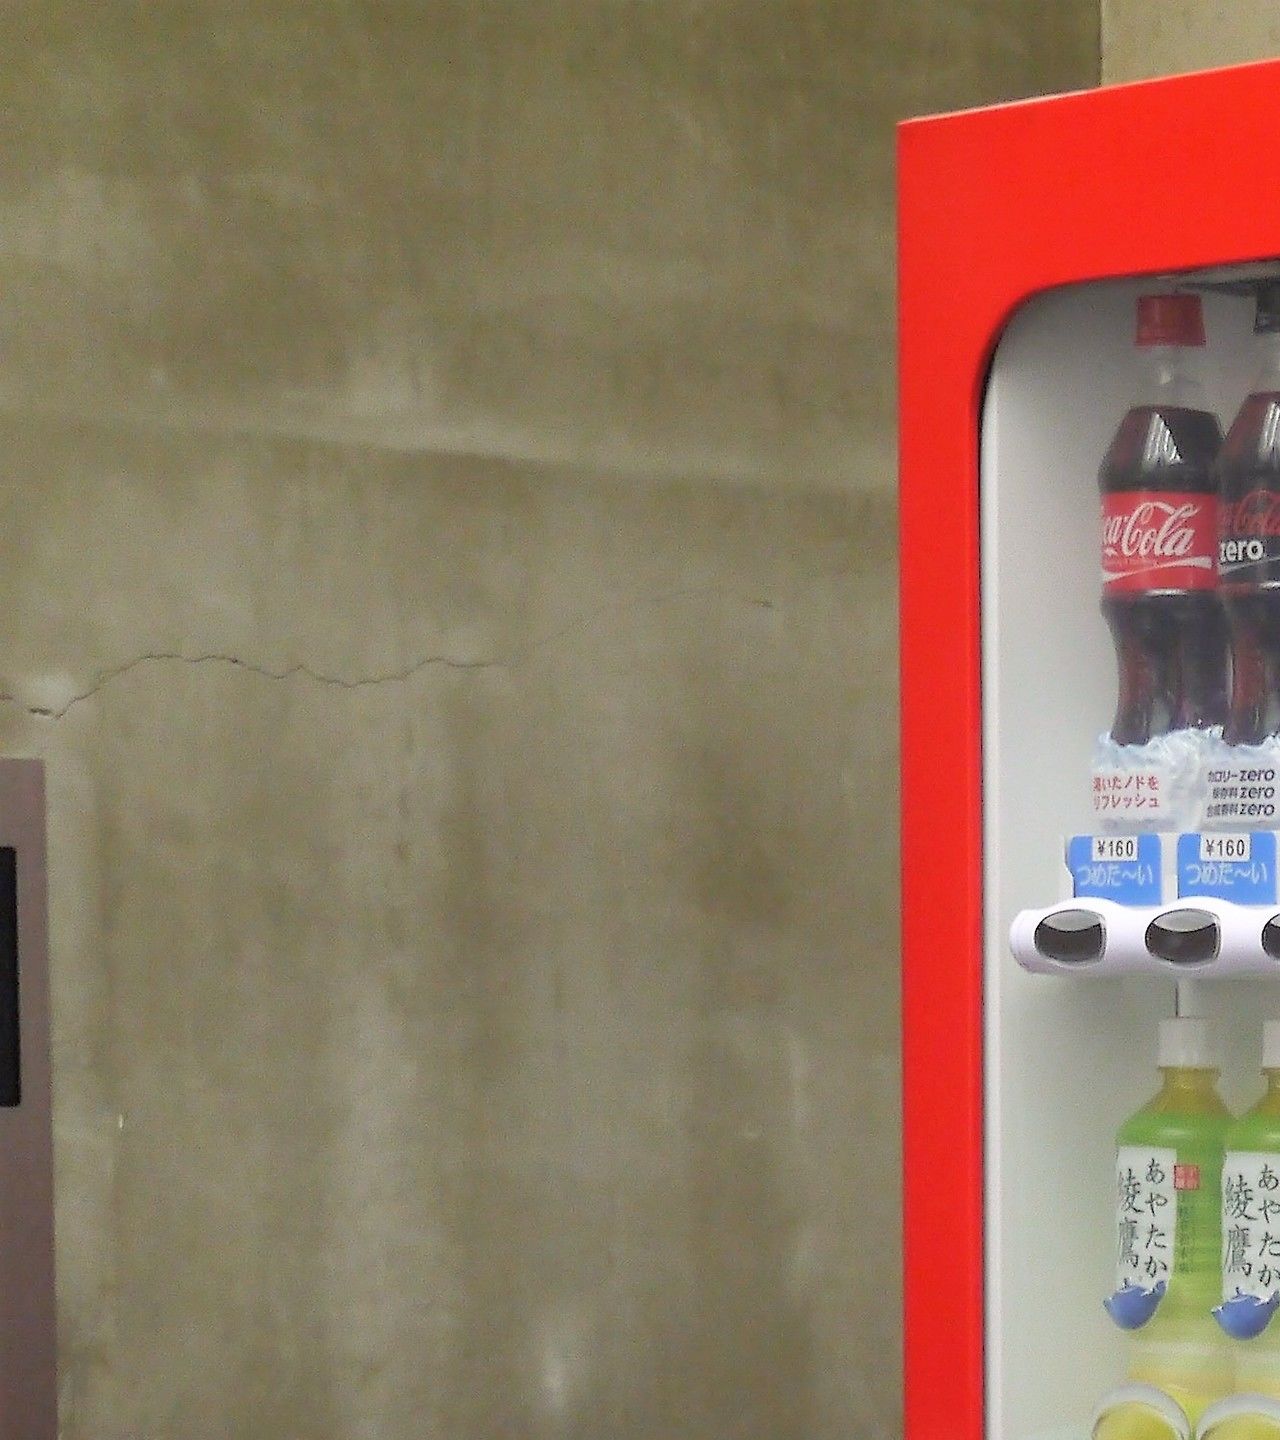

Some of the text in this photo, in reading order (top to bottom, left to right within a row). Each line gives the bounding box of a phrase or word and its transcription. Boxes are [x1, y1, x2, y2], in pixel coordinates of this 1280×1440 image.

[1097, 839, 1135, 858] ¥160
[1205, 839, 1245, 858] ¥160
[1144, 1157, 1168, 1281] あやたか
[1224, 1175, 1258, 1277] 綾鷹
